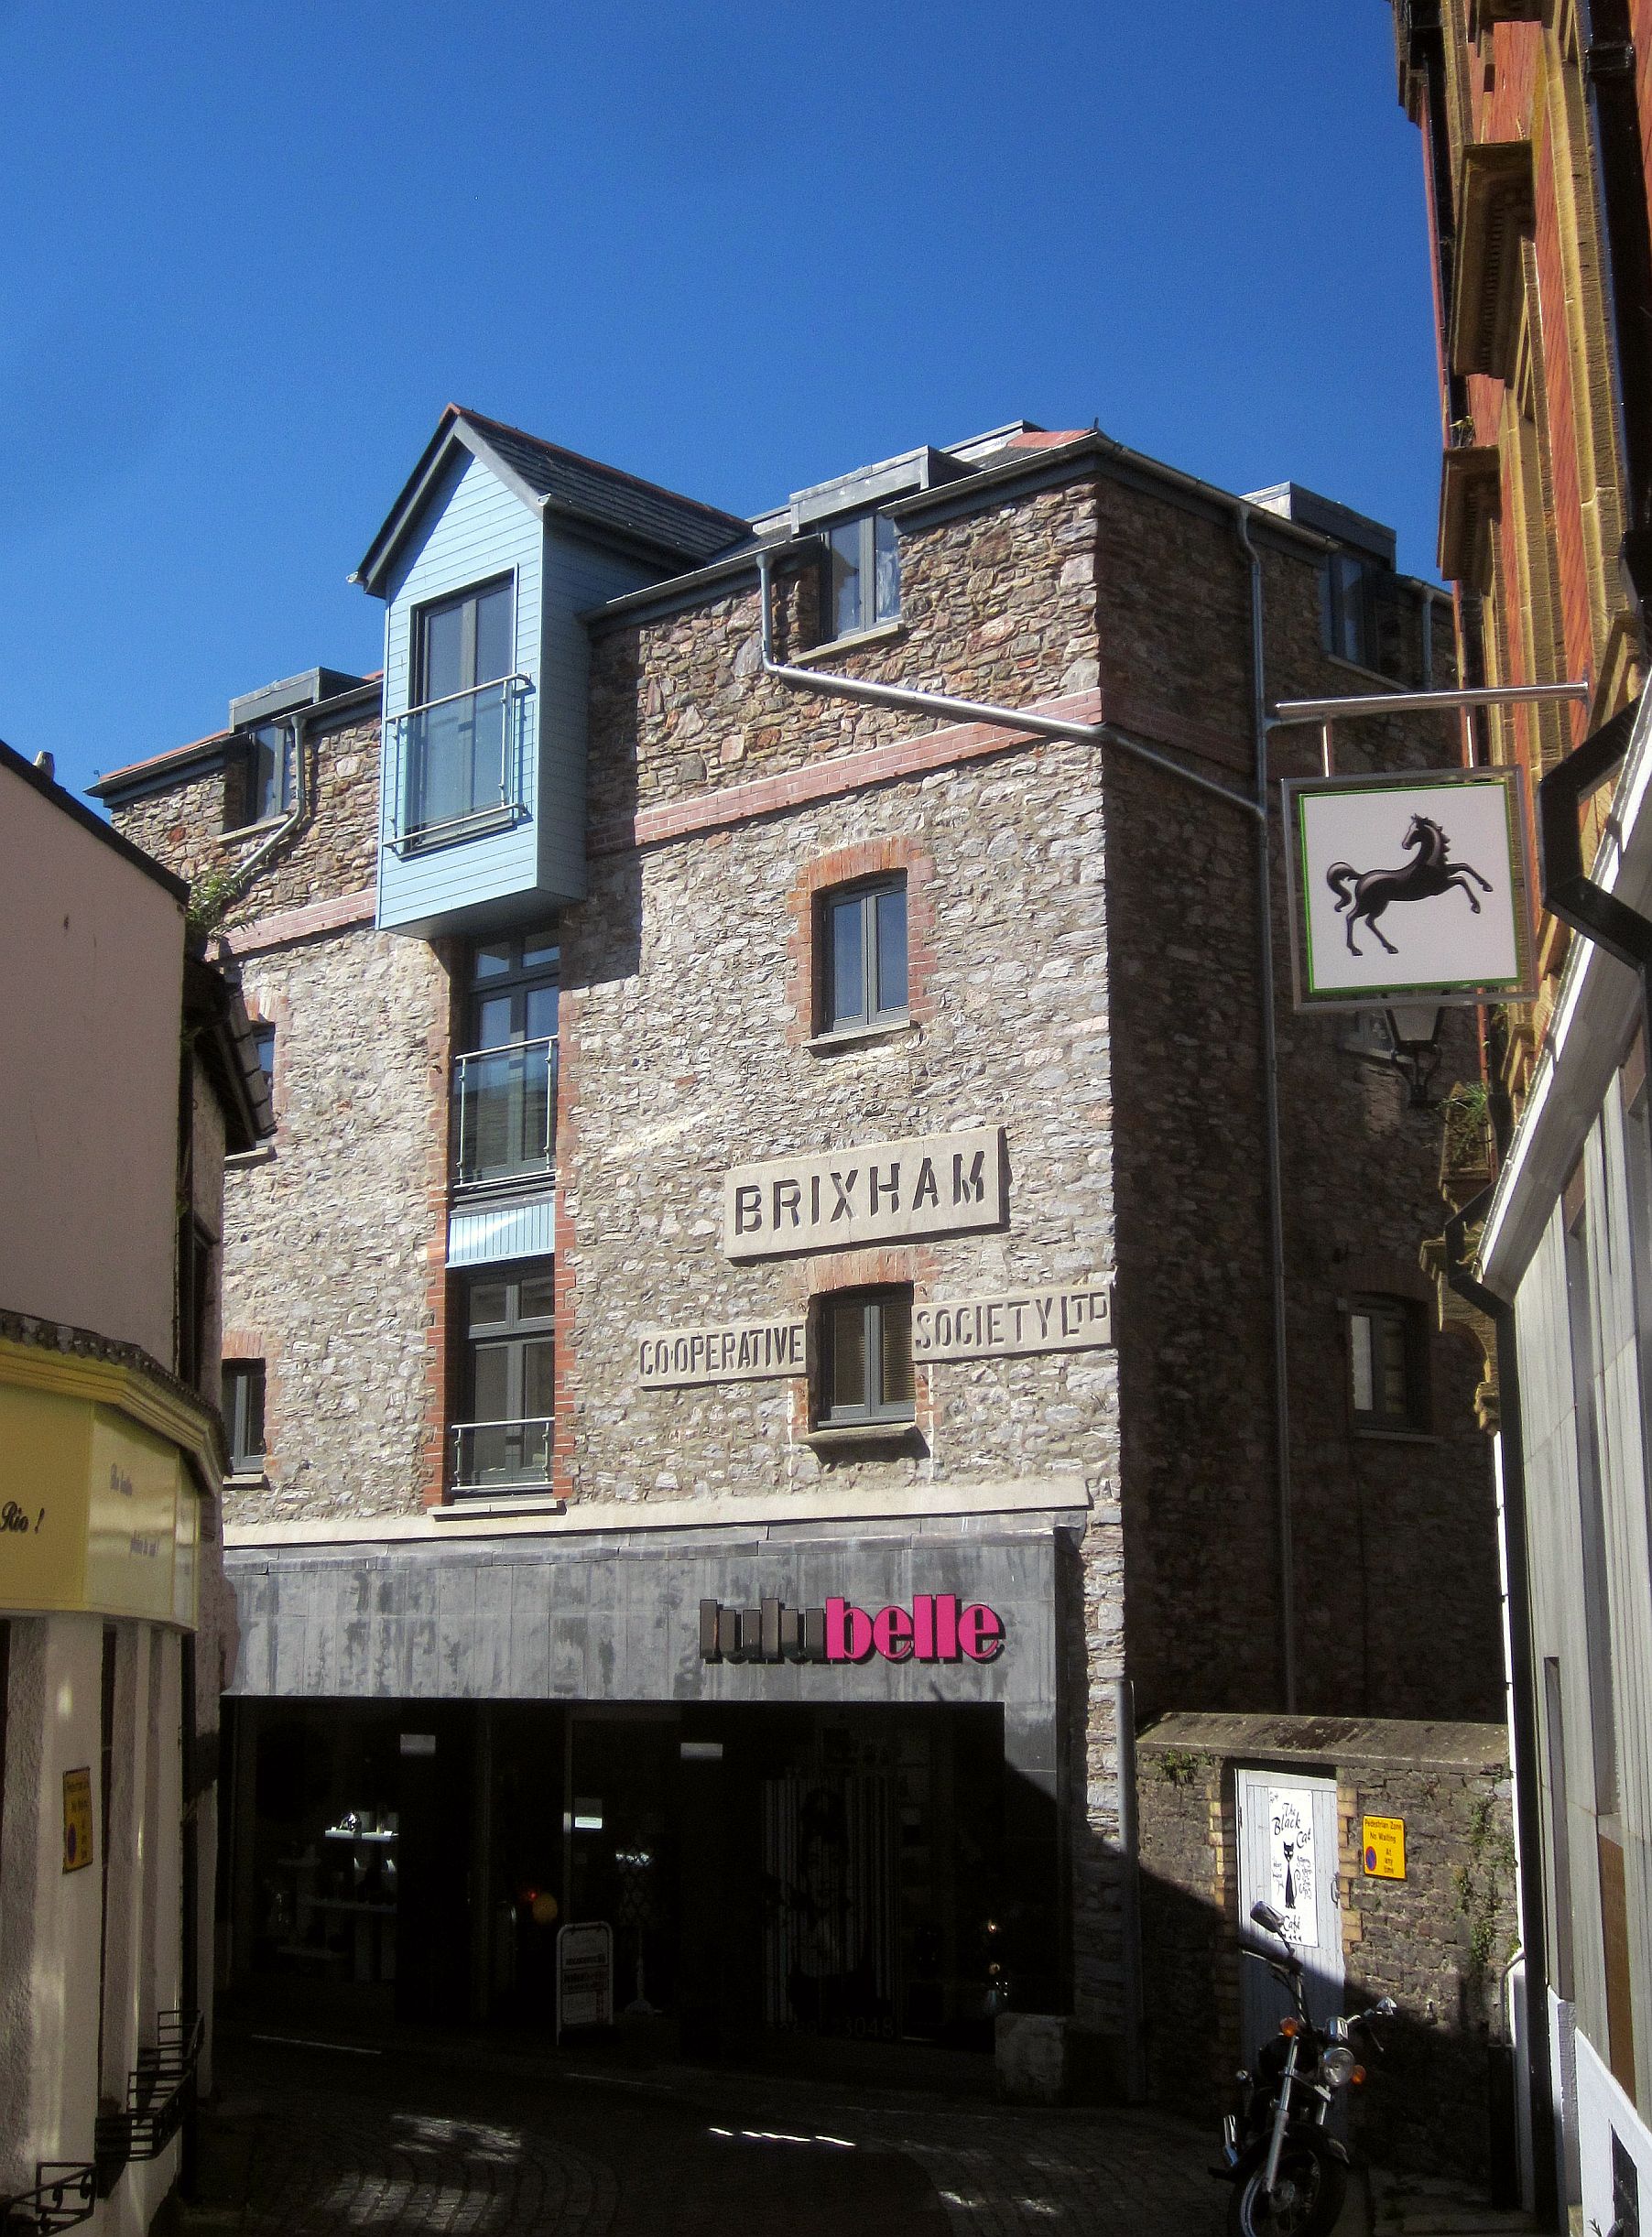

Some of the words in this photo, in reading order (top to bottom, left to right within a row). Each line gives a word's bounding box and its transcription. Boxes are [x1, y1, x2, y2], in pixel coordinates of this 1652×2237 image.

[734, 1150, 985, 1237] BRIXHAM
[916, 1287, 1053, 1350] SOCIETY
[1060, 1291, 1108, 1338] LTD
[1282, 1802, 1296, 1818] The
[1272, 1817, 1300, 1835] Black
[1297, 1827, 1310, 1849] Cat
[1370, 1831, 1377, 1840] No
[1378, 1832, 1397, 1844] Waiting
